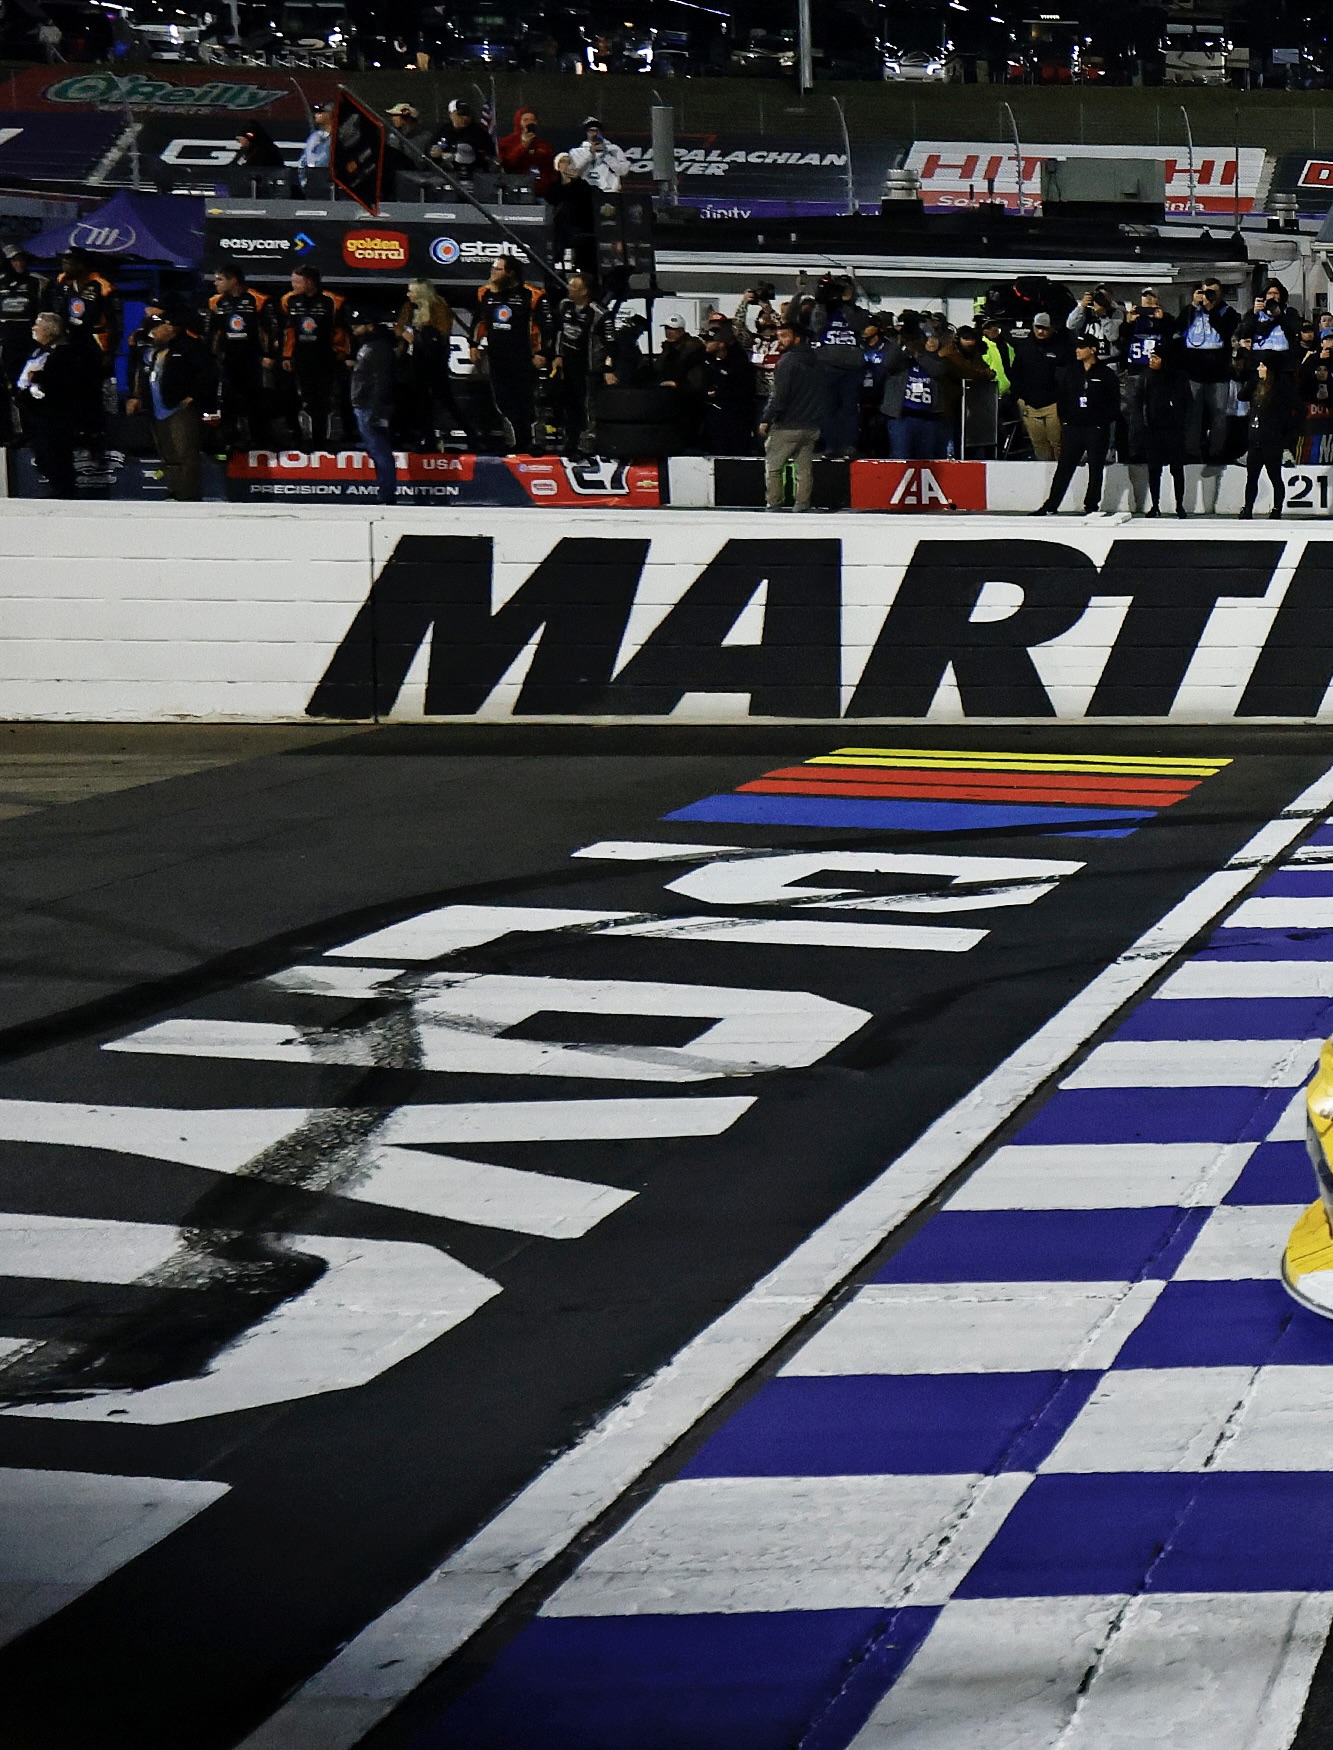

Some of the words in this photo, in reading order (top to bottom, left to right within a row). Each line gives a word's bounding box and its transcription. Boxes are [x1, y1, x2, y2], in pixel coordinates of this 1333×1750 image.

[220, 237, 291, 251] easycare
[347, 238, 400, 251] golden
[355, 249, 405, 260] corral
[422, 459, 463, 470] USA
[250, 484, 341, 496] PRECISION
[1287, 474, 1329, 508] 21
